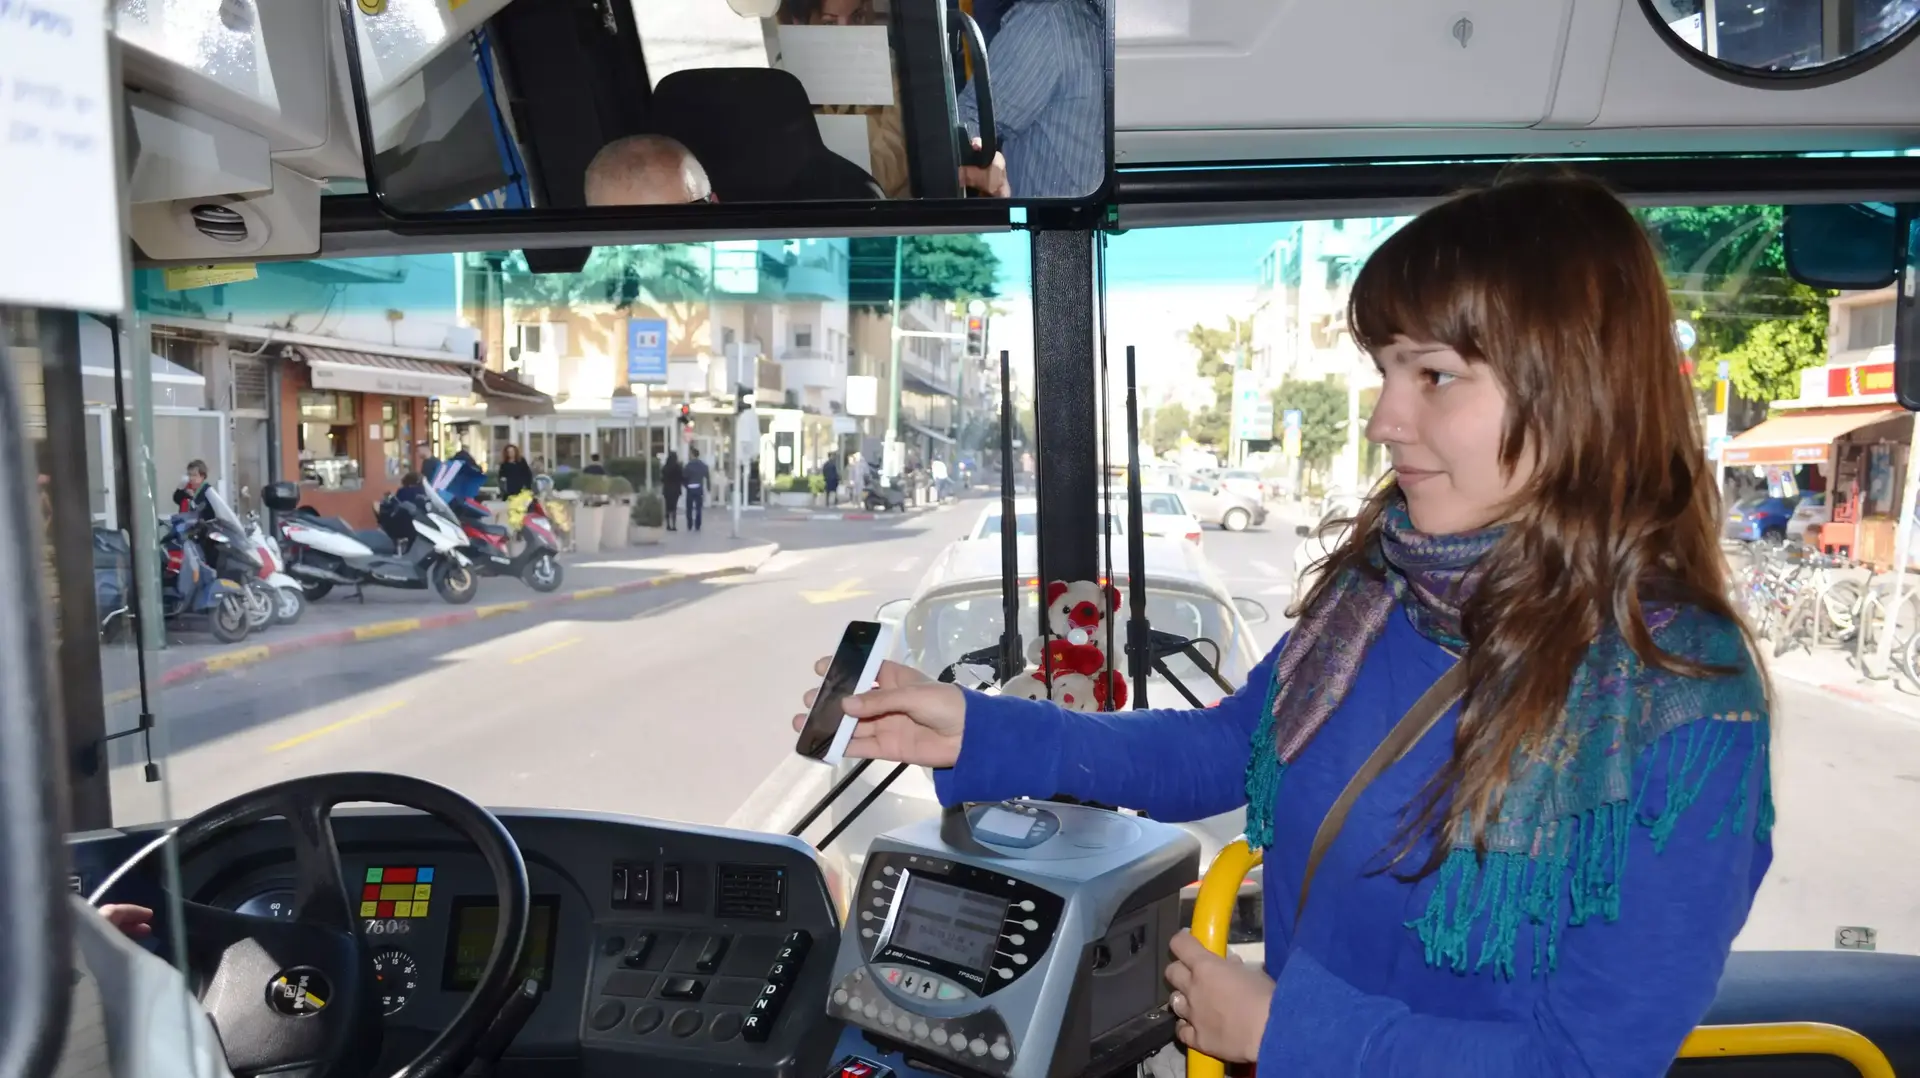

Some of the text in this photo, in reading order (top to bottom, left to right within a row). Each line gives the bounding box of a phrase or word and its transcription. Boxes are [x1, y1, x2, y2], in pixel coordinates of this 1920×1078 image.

[365, 919, 410, 934] 7606
[791, 932, 799, 941] 1
[782, 948, 792, 957] 2
[403, 966, 412, 974] 20
[774, 964, 783, 974] 3
[293, 975, 310, 1009] MAN
[765, 984, 777, 994] D
[756, 999, 769, 1009] N
[746, 1016, 758, 1027] R
